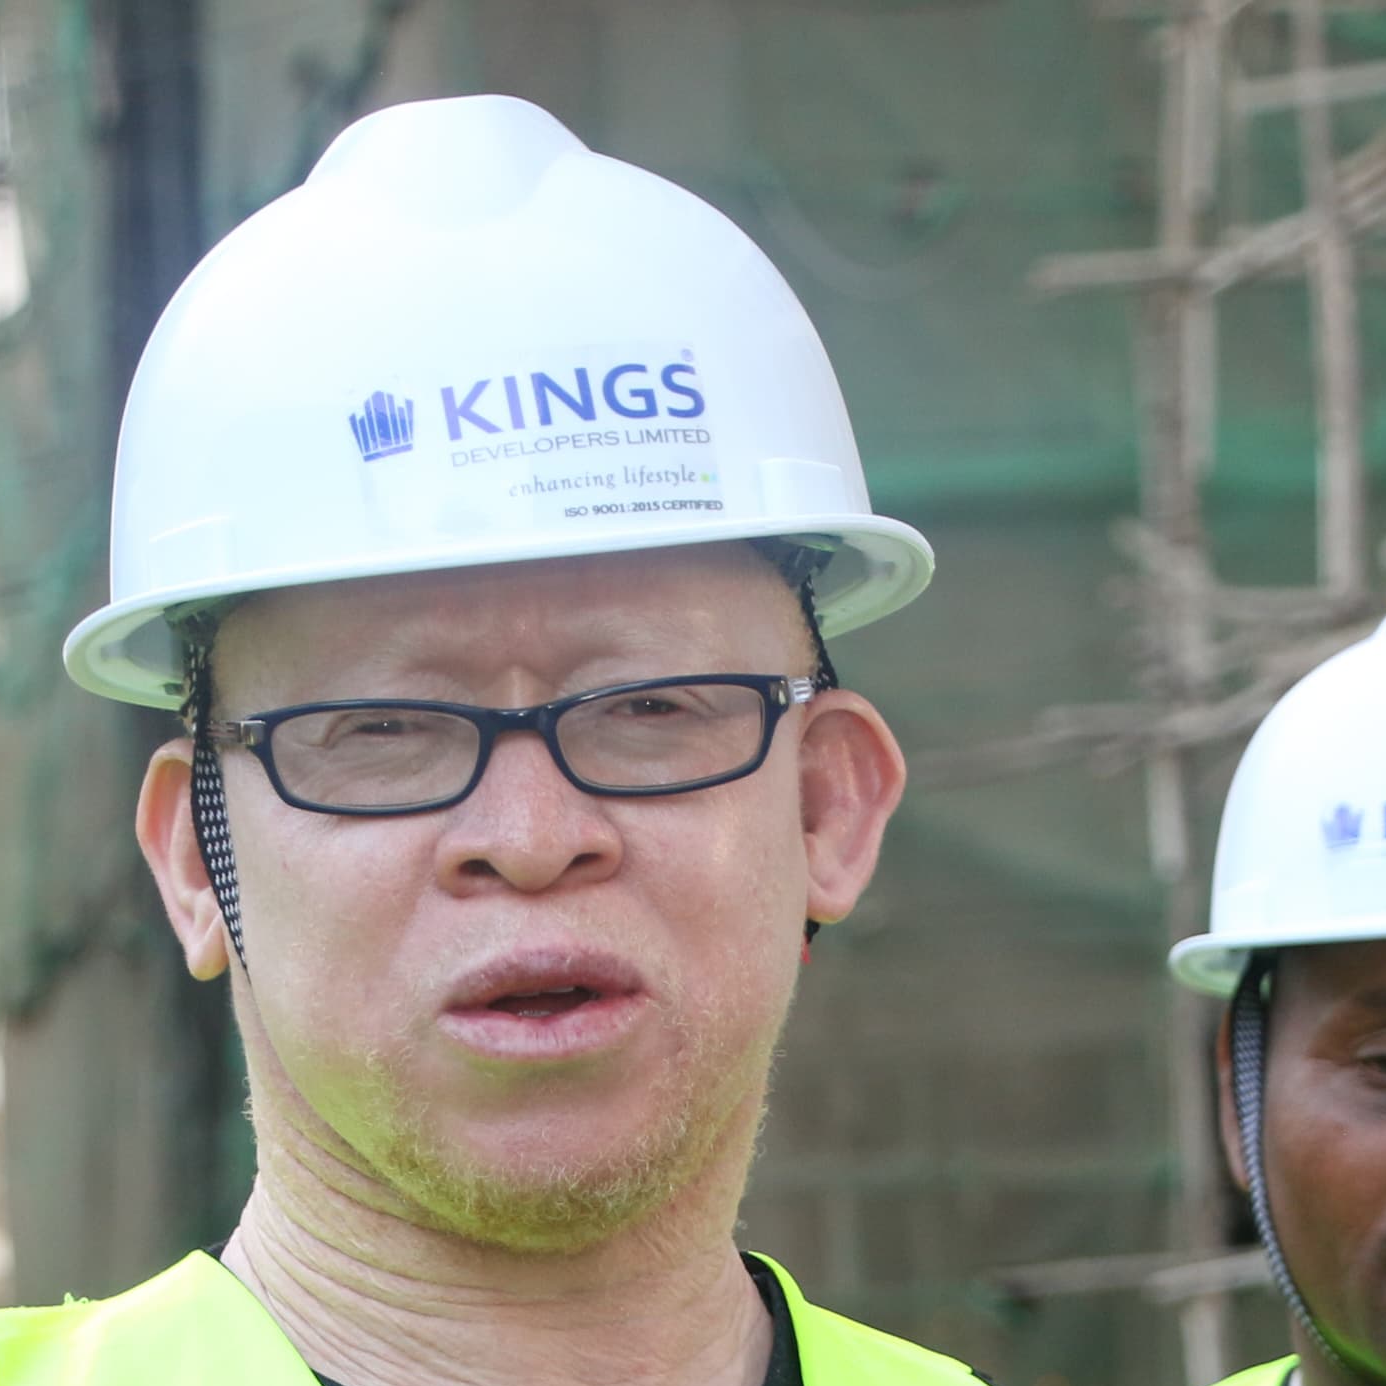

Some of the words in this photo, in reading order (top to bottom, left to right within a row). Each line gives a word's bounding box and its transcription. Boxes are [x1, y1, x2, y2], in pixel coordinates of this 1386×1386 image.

[440, 362, 706, 441] KINGS
[451, 430, 620, 468] DEVELOPERS
[625, 428, 710, 445] LIMITED
[509, 471, 616, 497] enhancing
[623, 464, 697, 489] lifestyle
[565, 506, 588, 518] ISO
[592, 500, 660, 515] 9001:2015
[662, 499, 723, 511] CERTIFIED
